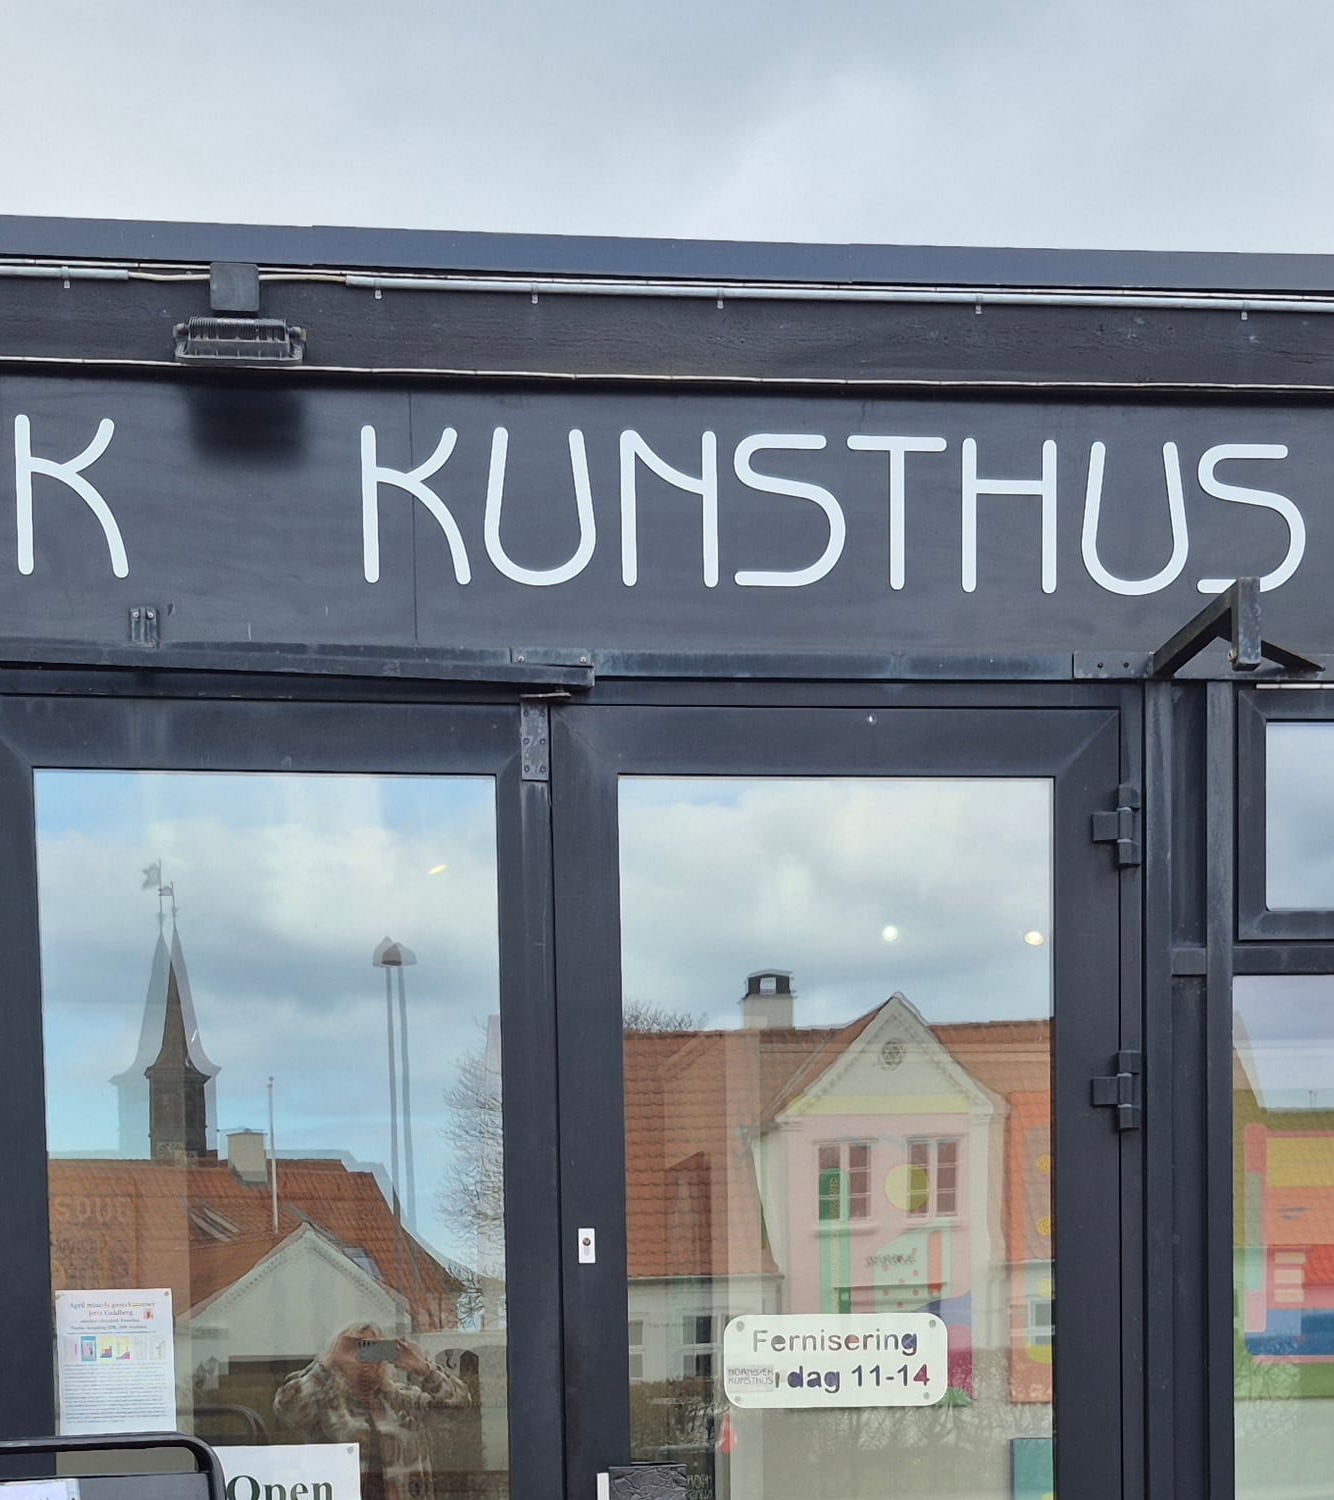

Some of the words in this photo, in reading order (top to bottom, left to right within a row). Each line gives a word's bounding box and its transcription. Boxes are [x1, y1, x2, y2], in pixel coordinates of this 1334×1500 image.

[361, 424, 1307, 596] KUNSTHUS
[753, 1329, 917, 1356] Fernisering
[851, 1363, 930, 1387] 11-14
